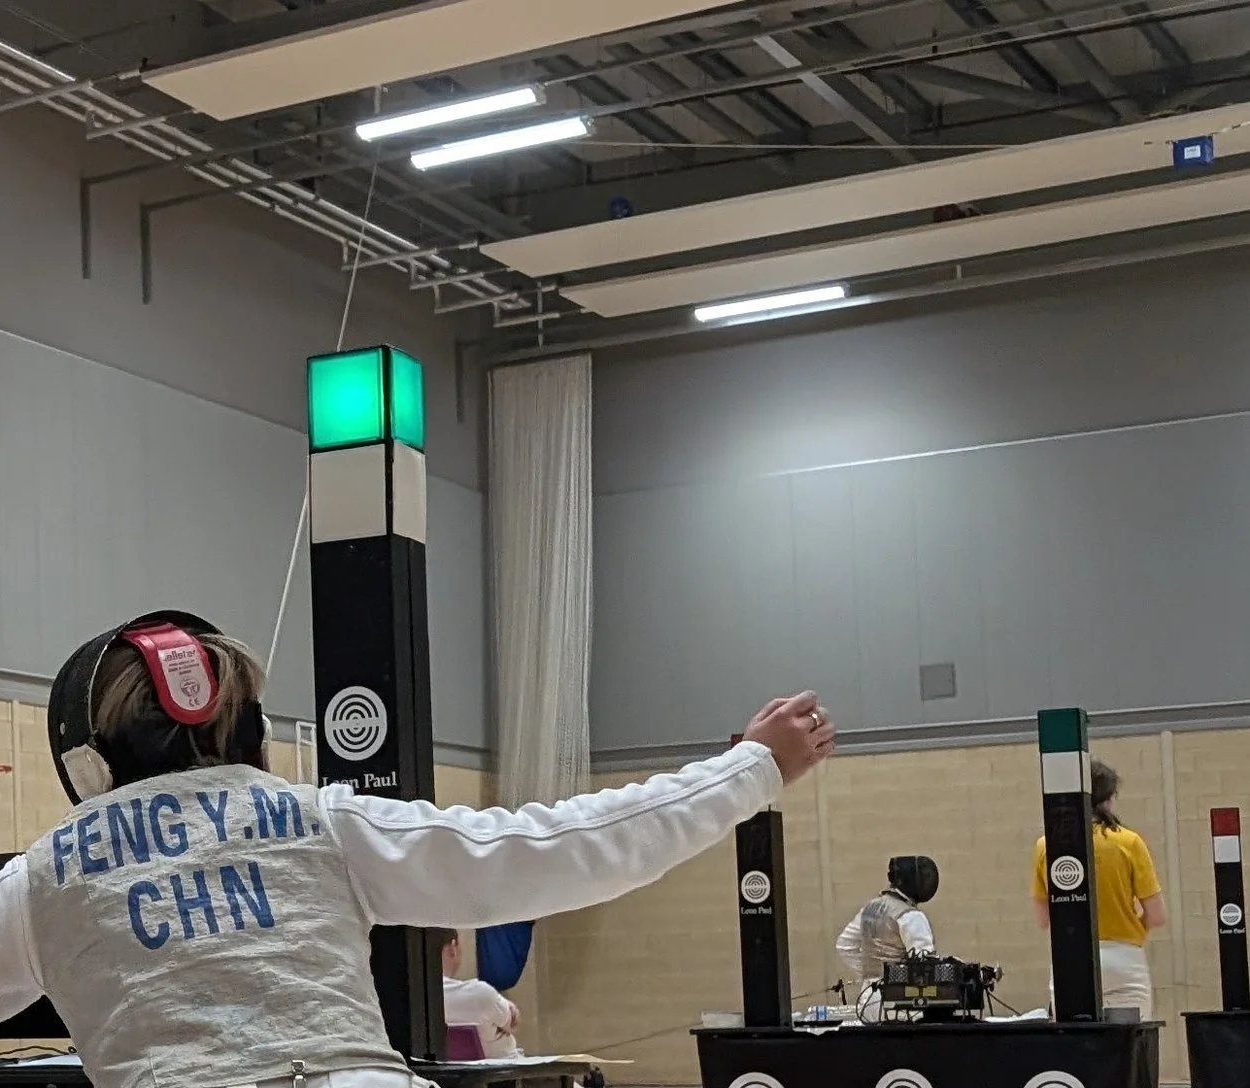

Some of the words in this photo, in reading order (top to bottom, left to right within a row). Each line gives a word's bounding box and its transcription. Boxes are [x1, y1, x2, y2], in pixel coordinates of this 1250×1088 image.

[363, 771, 397, 788] Paul
[53, 793, 189, 885] FENG
[128, 862, 274, 949] CHN
